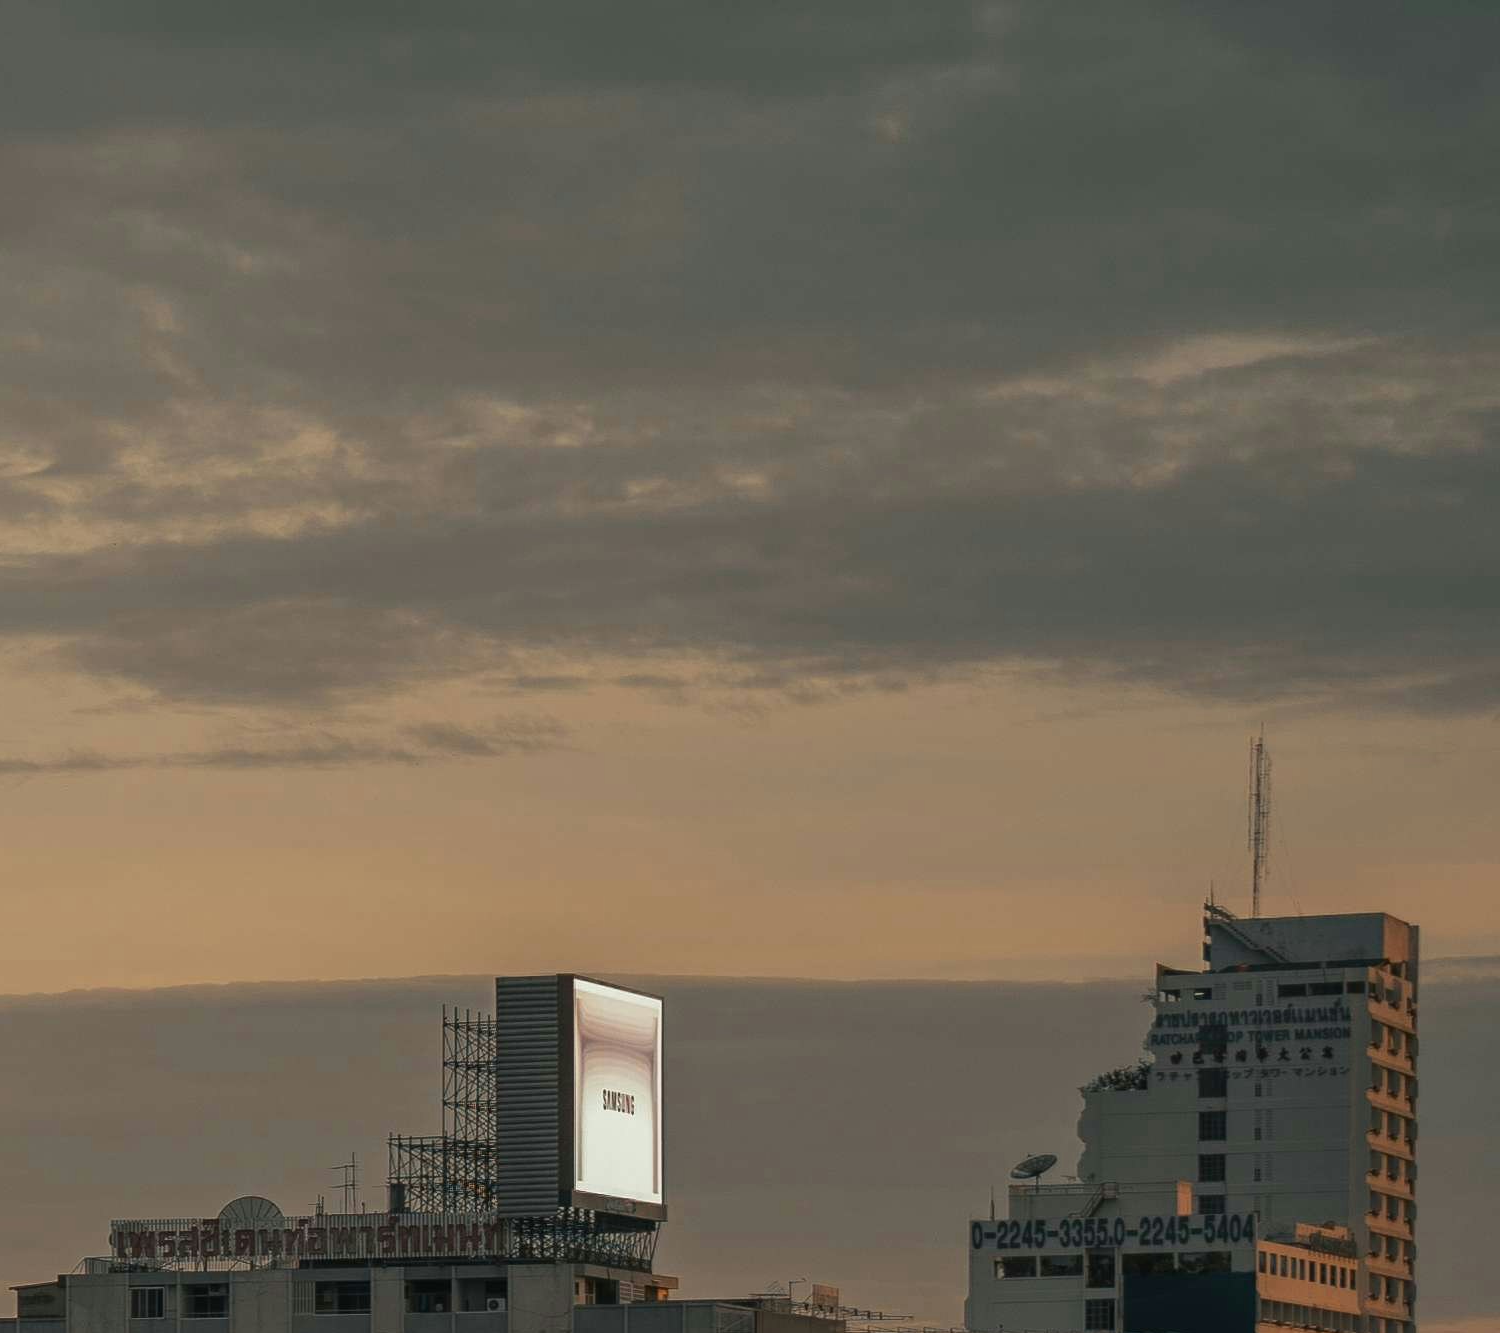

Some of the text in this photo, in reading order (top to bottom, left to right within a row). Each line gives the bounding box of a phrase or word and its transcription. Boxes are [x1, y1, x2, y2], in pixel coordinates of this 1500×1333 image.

[1250, 1028, 1291, 1043] TOWER
[1295, 1026, 1351, 1041] MANSION
[603, 1089, 635, 1116] SAMSUNG
